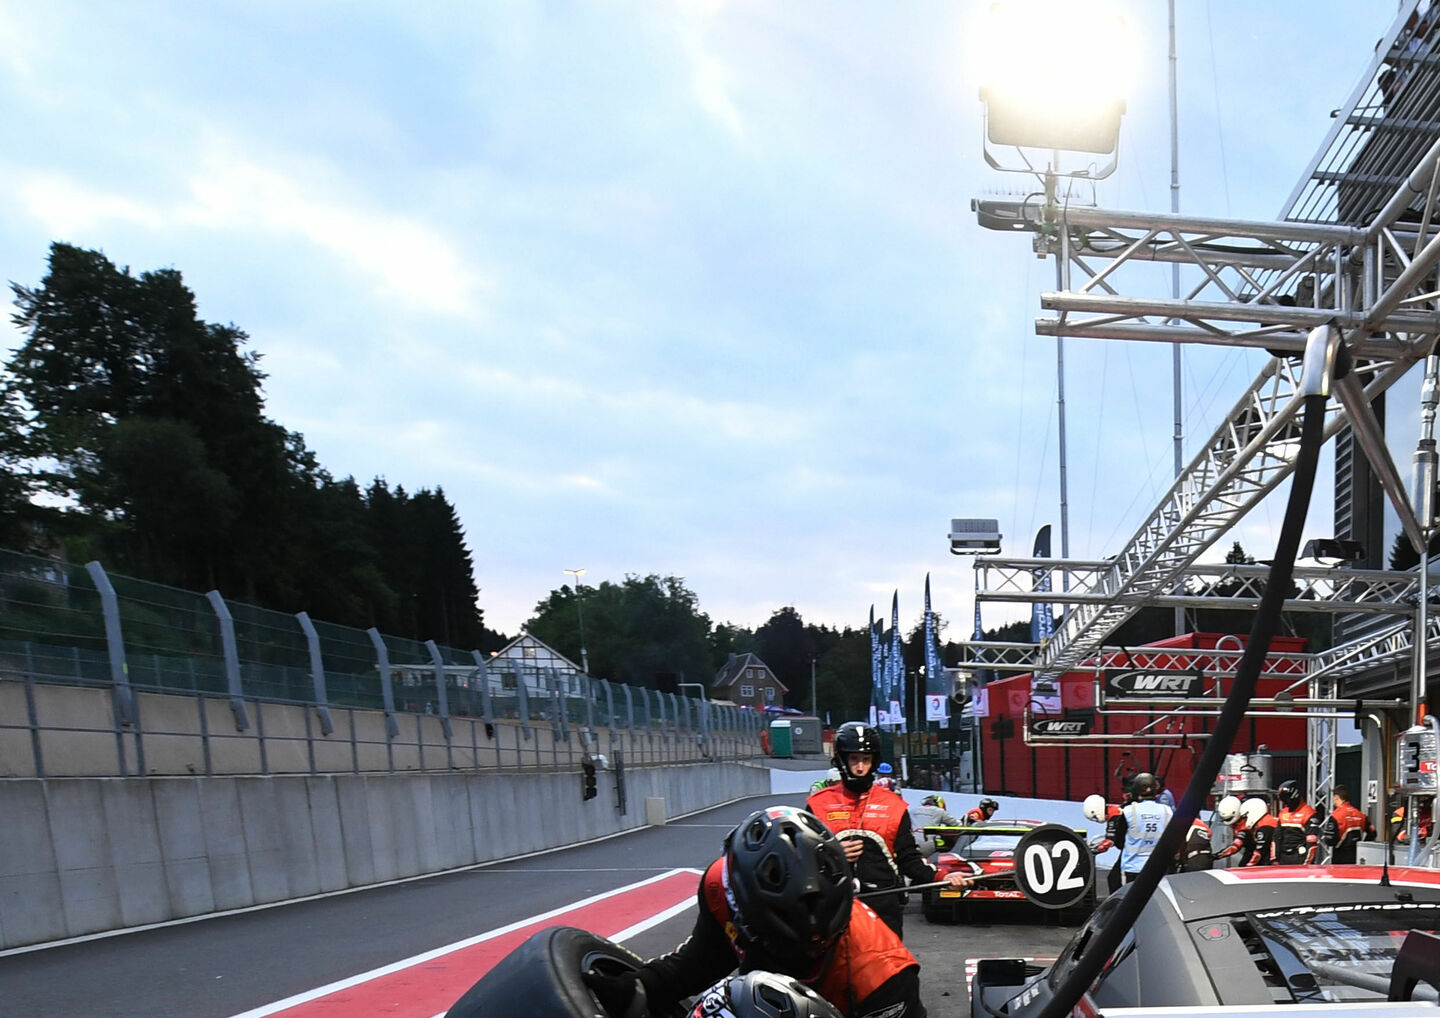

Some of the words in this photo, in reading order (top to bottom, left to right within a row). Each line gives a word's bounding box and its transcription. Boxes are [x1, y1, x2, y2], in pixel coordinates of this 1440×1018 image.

[1133, 675, 1198, 691] WRT
[1046, 721, 1086, 731] WRT
[1408, 742, 1420, 773] 3
[1145, 823, 1158, 832] 55
[1024, 840, 1085, 895] 02
